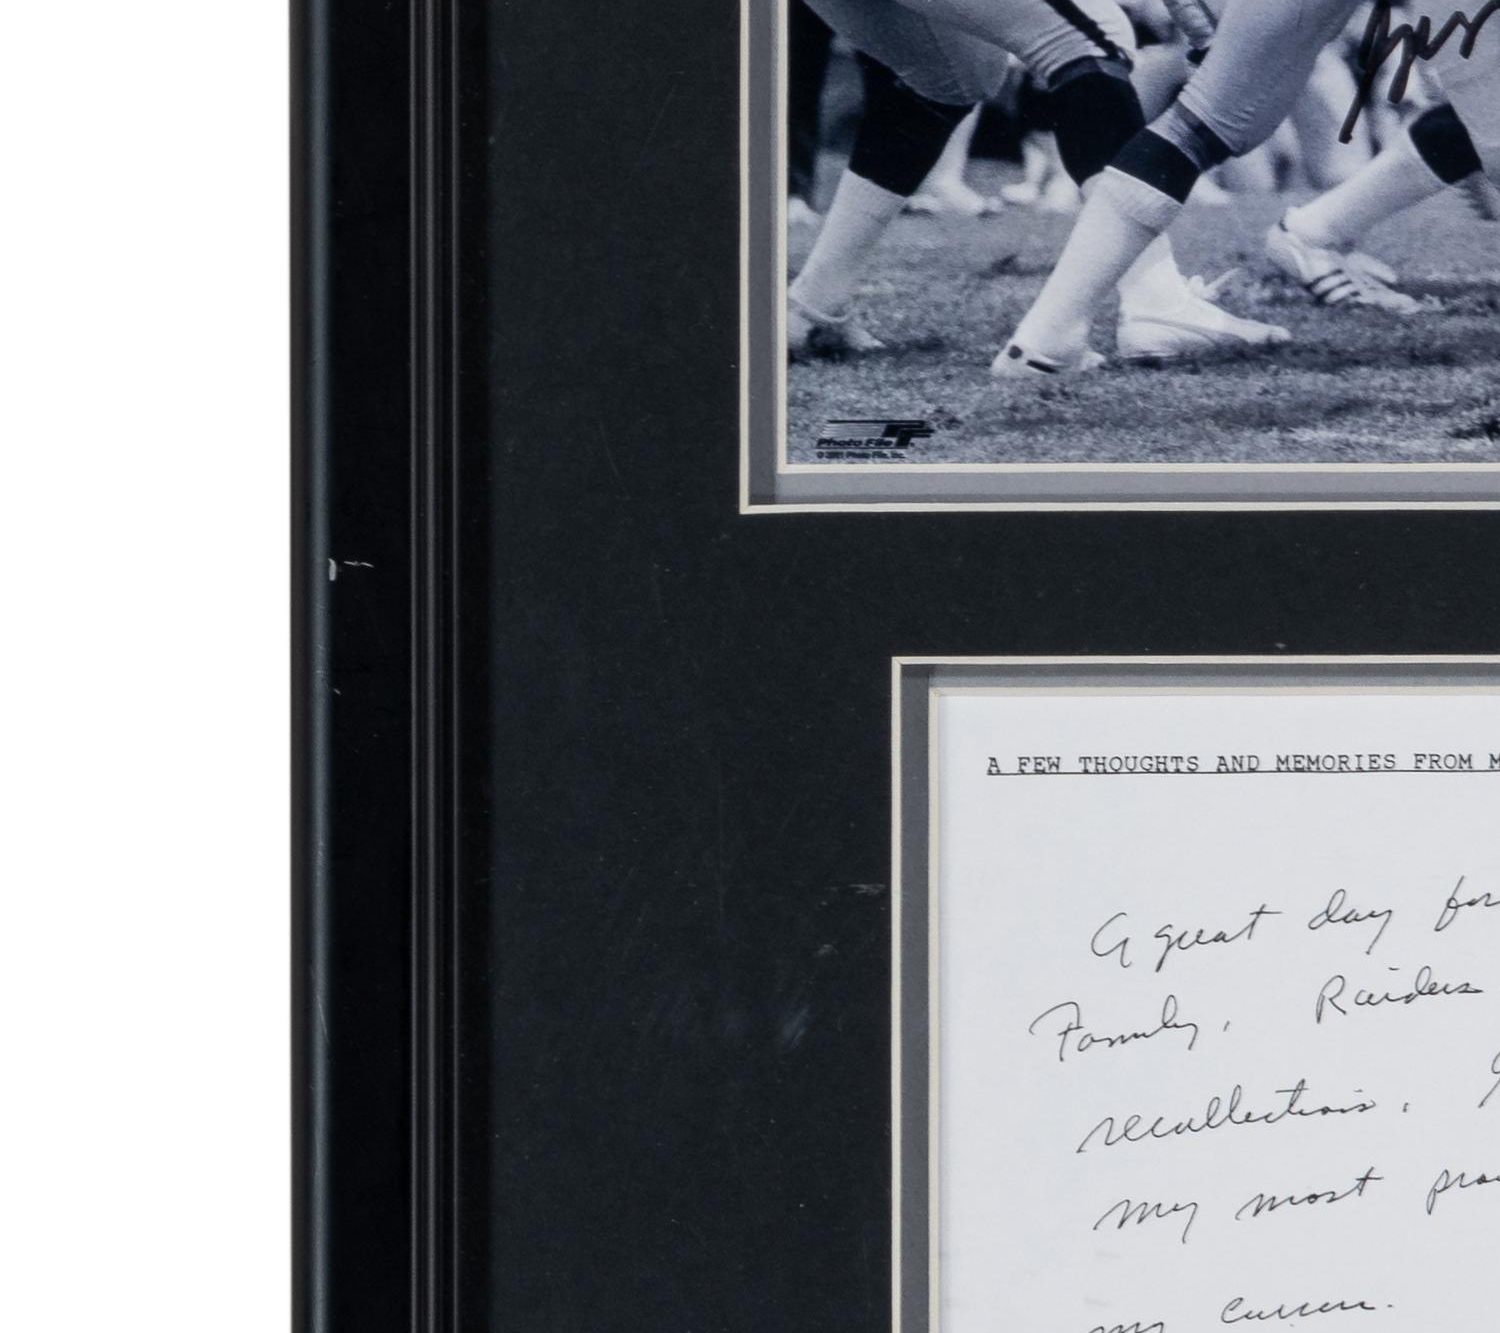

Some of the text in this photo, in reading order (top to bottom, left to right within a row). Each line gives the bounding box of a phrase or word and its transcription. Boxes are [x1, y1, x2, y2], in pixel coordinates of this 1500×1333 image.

[986, 755, 1001, 773] A
[1015, 754, 1062, 772] FEW
[1077, 754, 1201, 772] THOUGHTS
[1214, 753, 1260, 772] AND
[1274, 753, 1396, 771] MEMORIES
[1411, 752, 1474, 771] FROM
[1307, 888, 1394, 956] day
[1234, 1166, 1384, 1221] most
